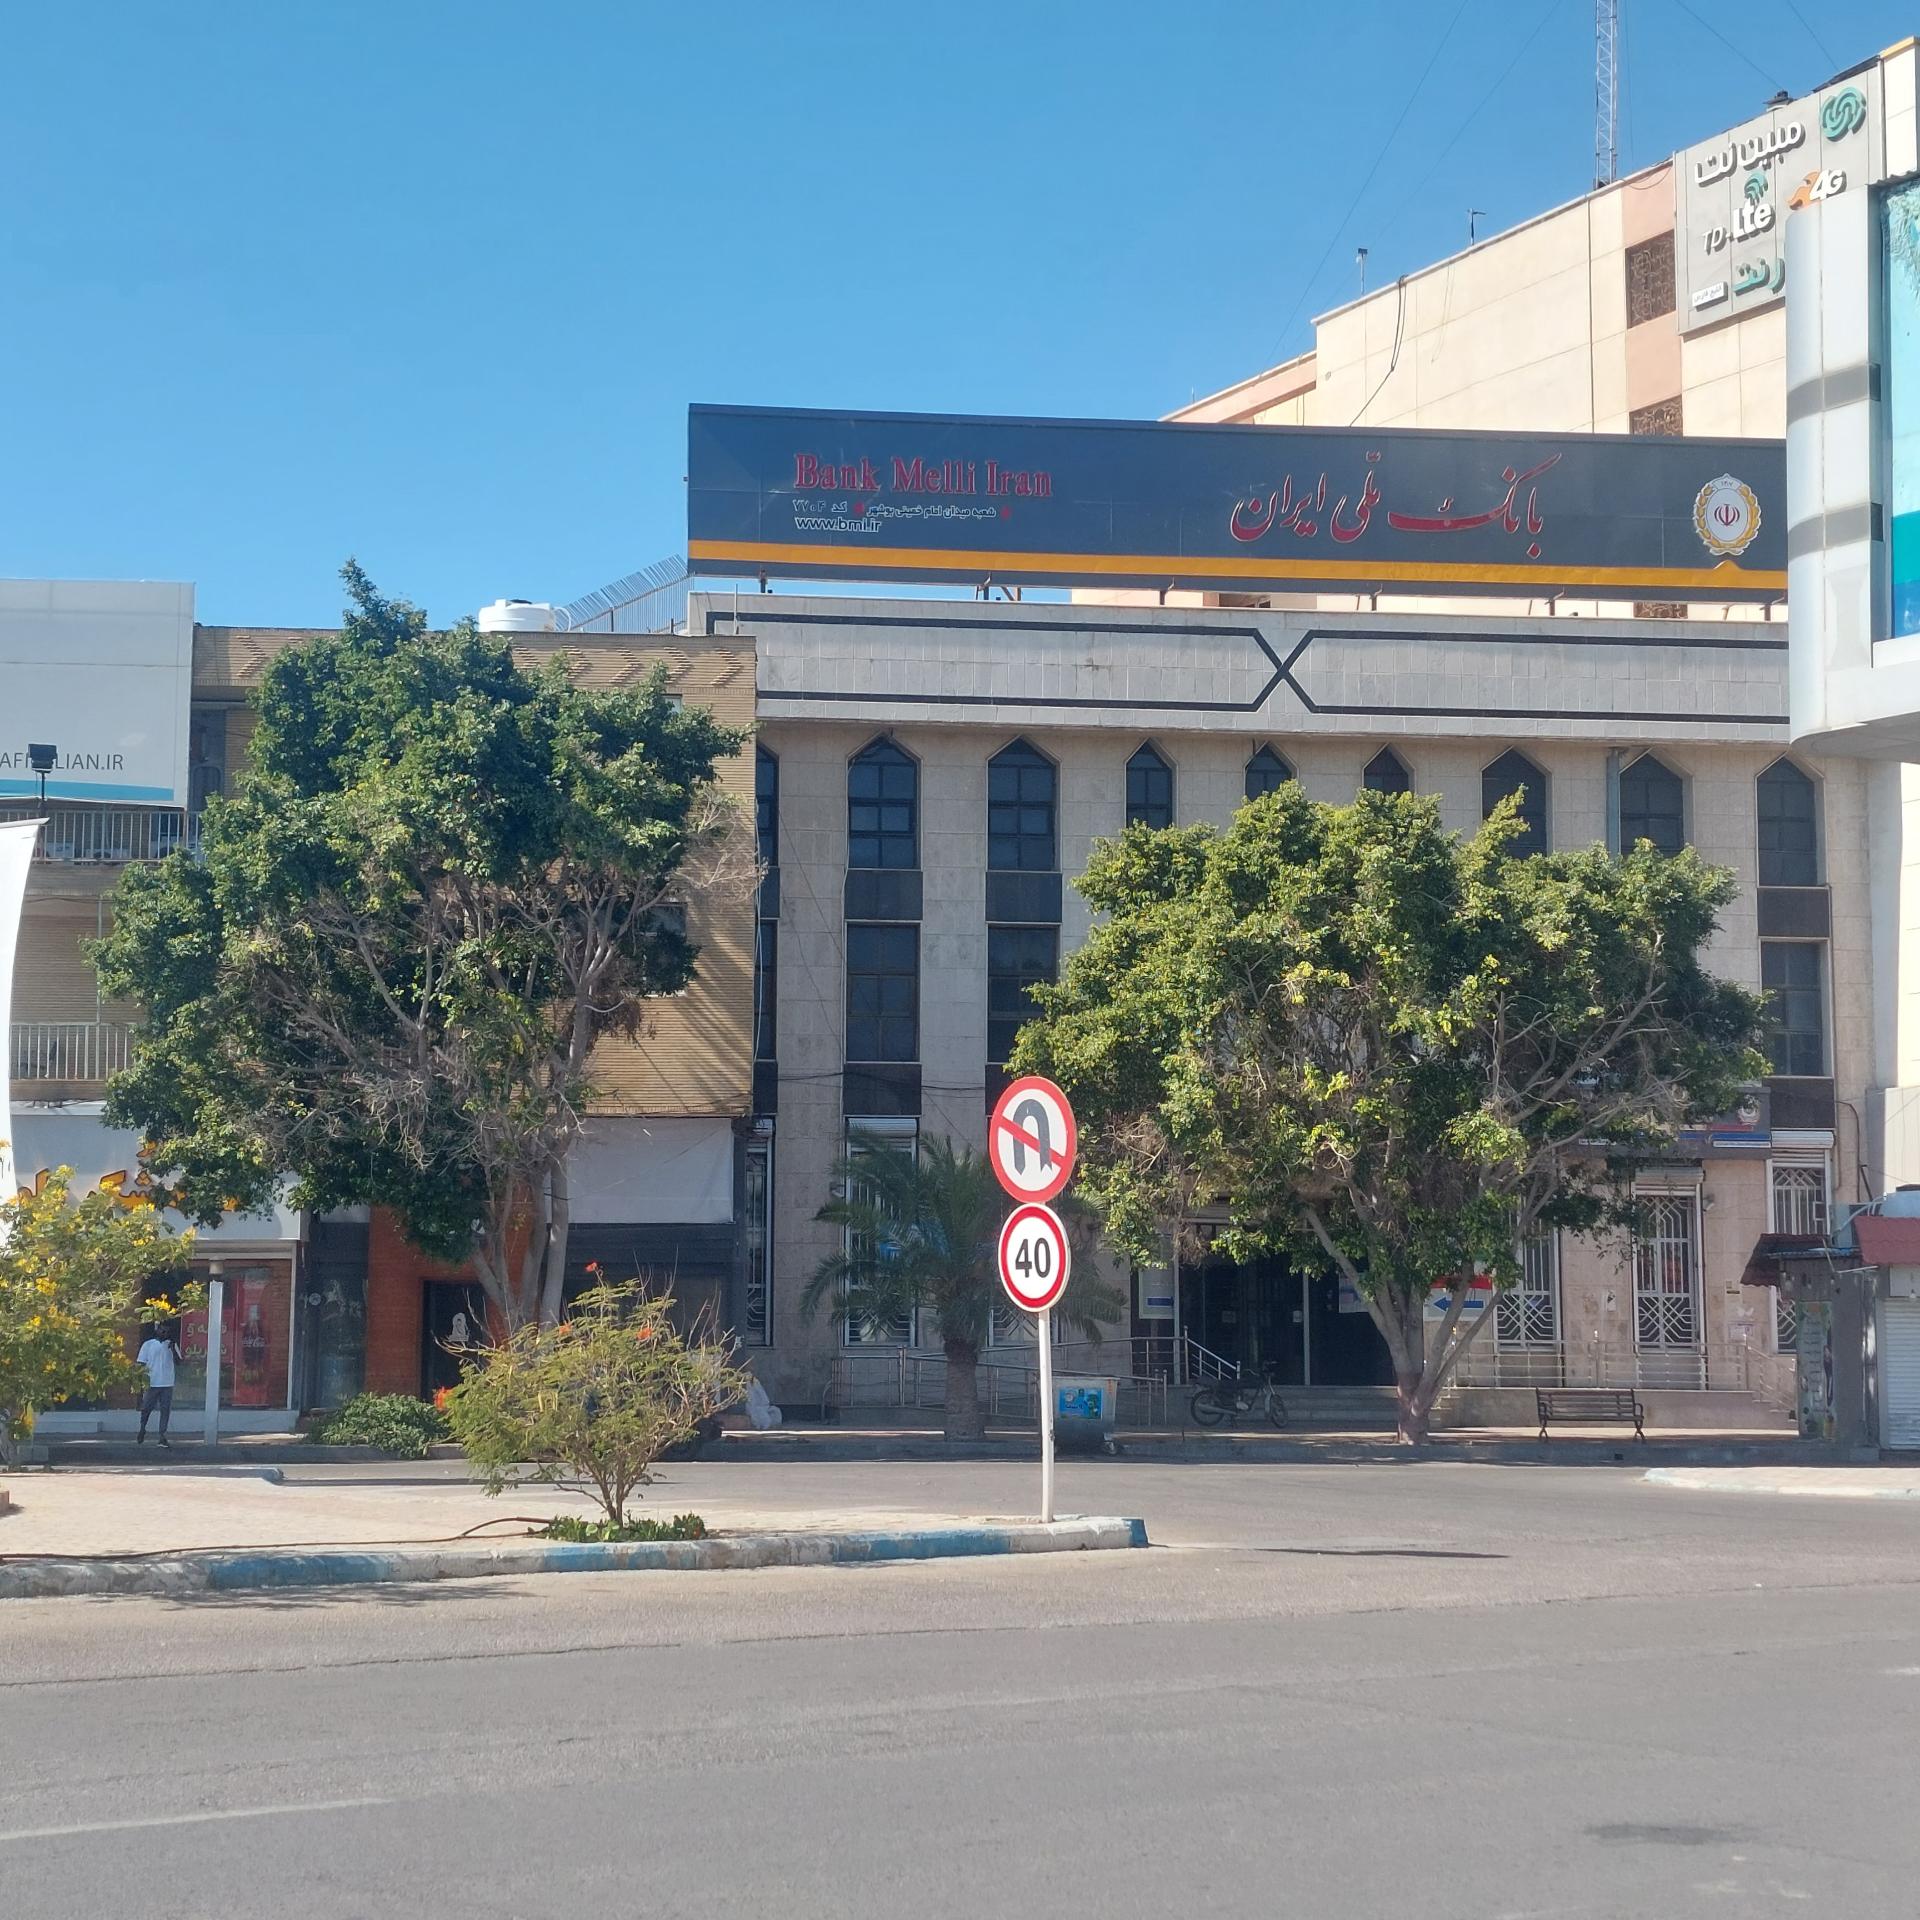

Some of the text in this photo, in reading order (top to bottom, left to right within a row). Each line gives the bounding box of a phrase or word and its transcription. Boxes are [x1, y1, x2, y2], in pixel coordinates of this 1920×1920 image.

[1809, 168, 1846, 200] 4G
[794, 453, 1053, 497] Bank Melli Iran
[894, 505, 922, 518] خمینی
[923, 505, 943, 519] امام
[944, 505, 970, 519] میدان
[971, 507, 996, 519] شعبه
[1230, 472, 1327, 542] ایران
[1388, 452, 1562, 559] بانک
[794, 516, 882, 532] www.bmi.ir
[1014, 1237, 1051, 1278] 40
